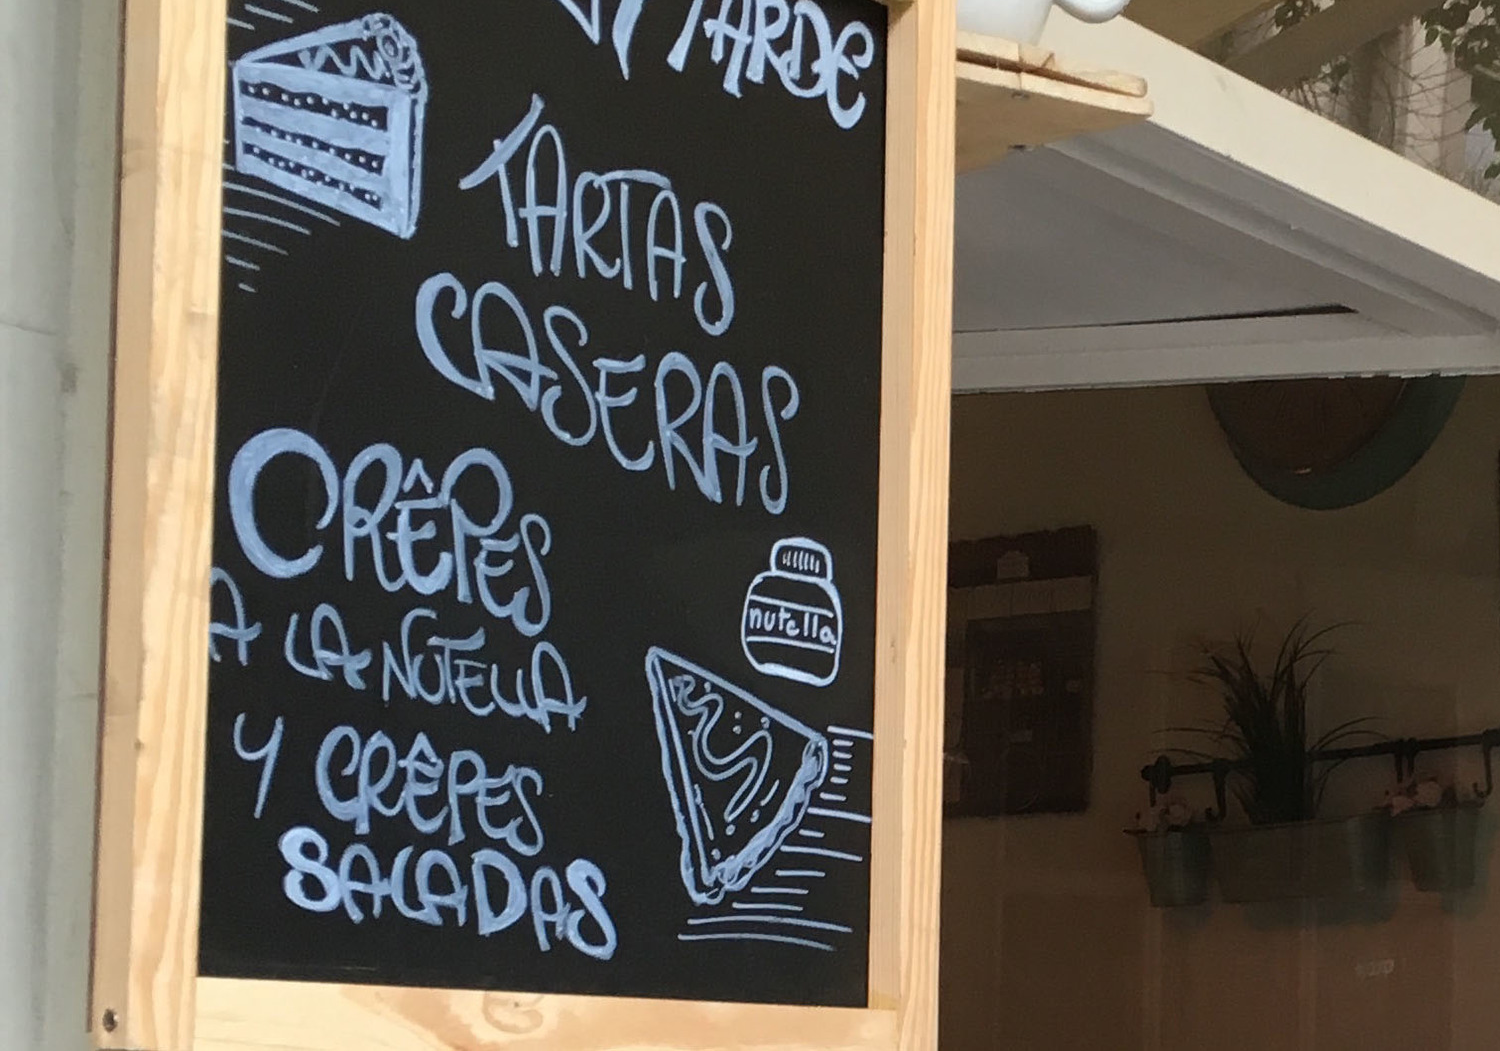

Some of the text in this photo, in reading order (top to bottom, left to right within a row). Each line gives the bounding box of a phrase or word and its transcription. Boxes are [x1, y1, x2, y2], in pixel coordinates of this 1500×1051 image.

[458, 93, 735, 336] TARTAS
[415, 271, 799, 515] CASERAS
[285, 603, 372, 690] LA
[748, 606, 838, 647] nutella
[278, 826, 618, 961] SALADAS
